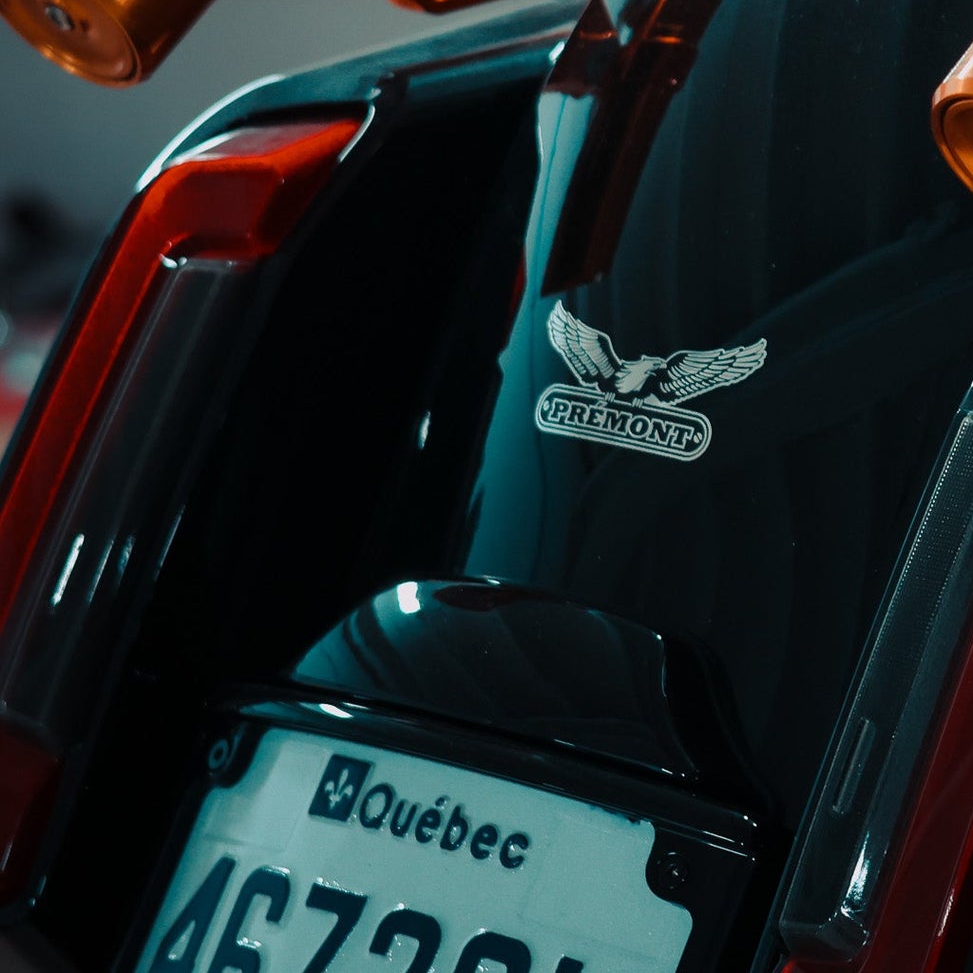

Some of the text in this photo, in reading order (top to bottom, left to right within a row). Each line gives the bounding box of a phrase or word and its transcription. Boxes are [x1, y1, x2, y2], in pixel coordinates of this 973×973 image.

[549, 398, 695, 449] PRÉMONT
[359, 782, 531, 870] Québec
[148, 856, 584, 973] 467
